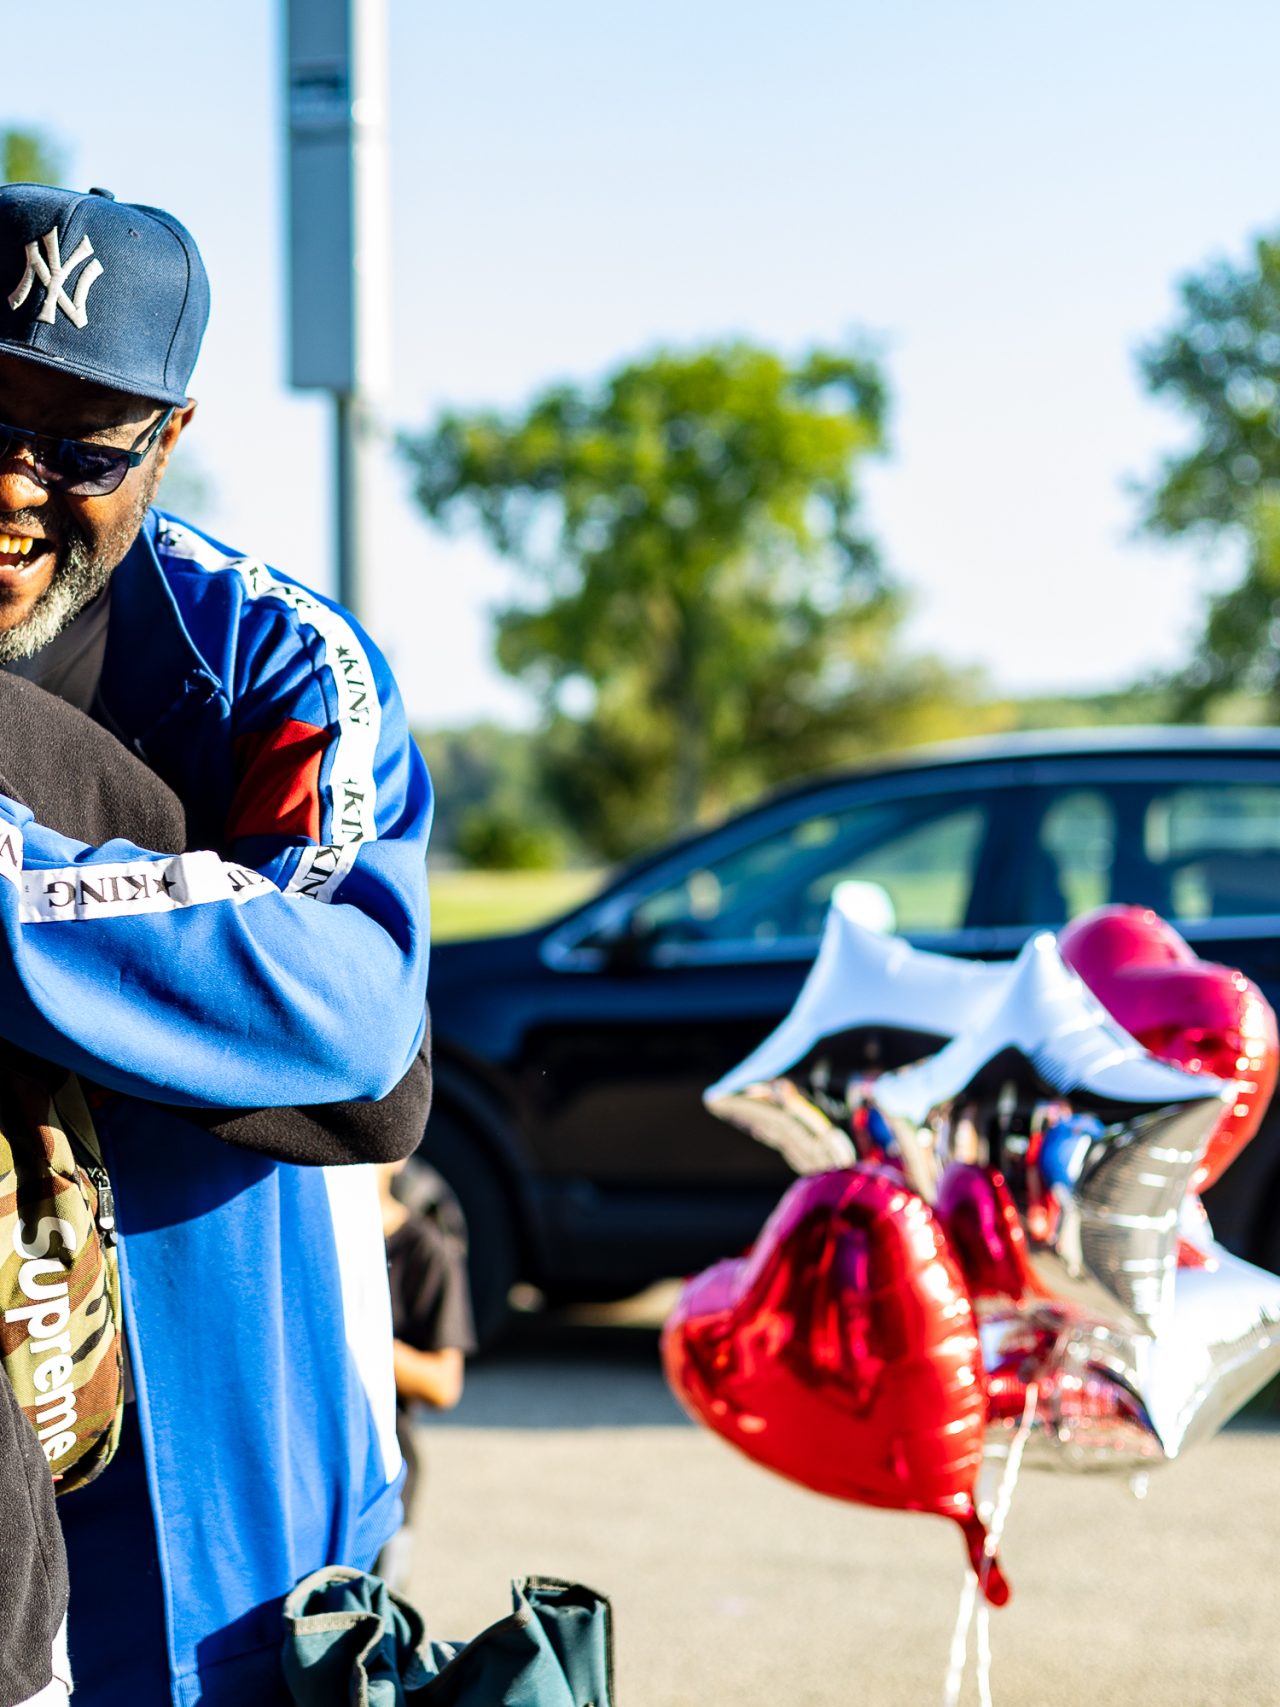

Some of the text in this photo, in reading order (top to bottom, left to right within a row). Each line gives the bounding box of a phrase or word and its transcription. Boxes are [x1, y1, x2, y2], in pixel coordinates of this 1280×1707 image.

[8, 225, 104, 329] NY
[44, 874, 152, 908] KING
[5, 1217, 77, 1462] Supreme
